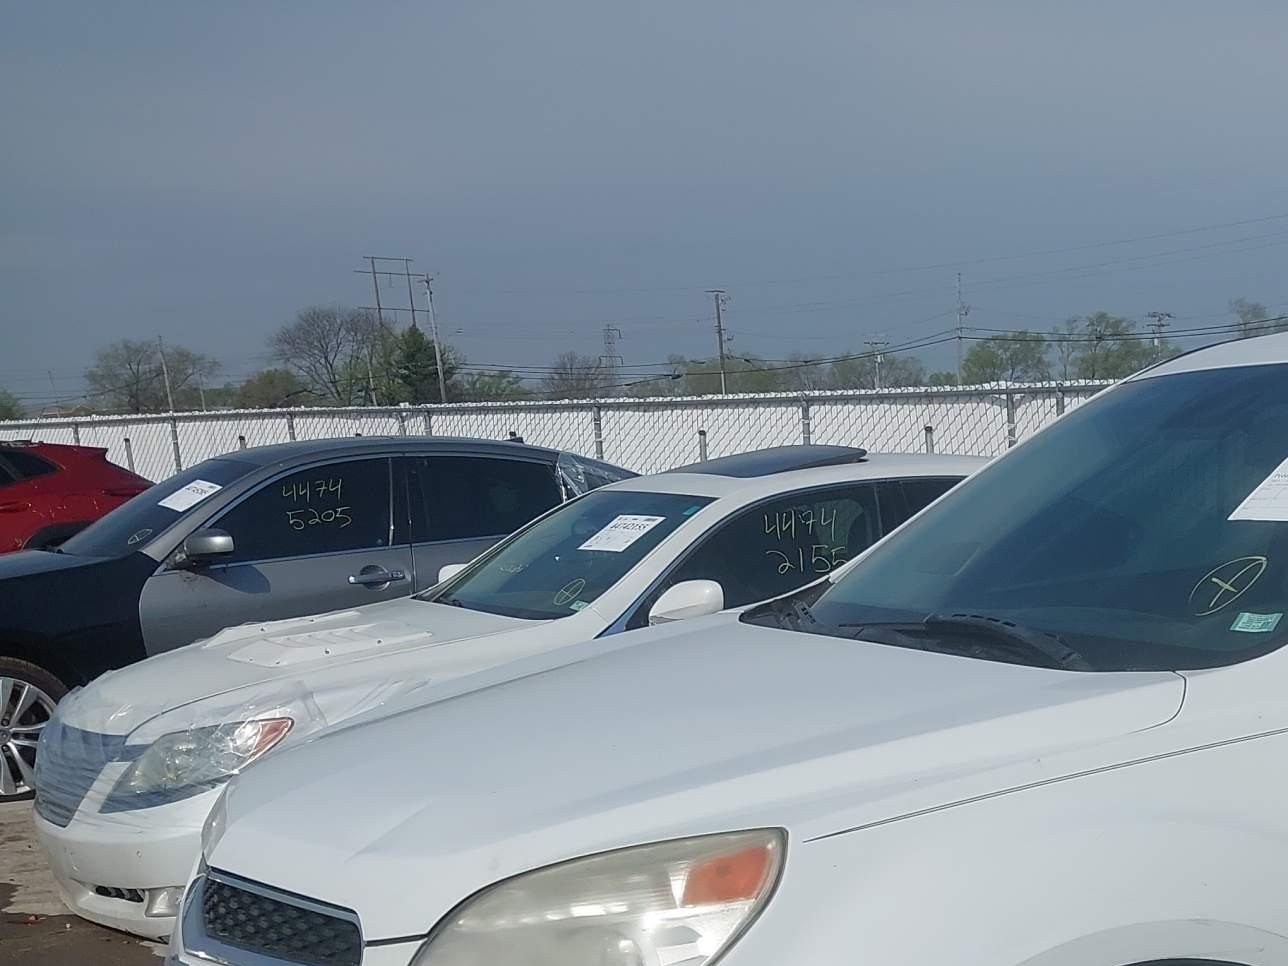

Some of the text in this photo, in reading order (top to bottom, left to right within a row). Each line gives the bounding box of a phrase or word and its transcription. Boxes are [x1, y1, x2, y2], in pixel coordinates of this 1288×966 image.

[282, 479, 342, 503] 4474
[286, 506, 352, 530] 5205
[763, 507, 837, 541] 4474
